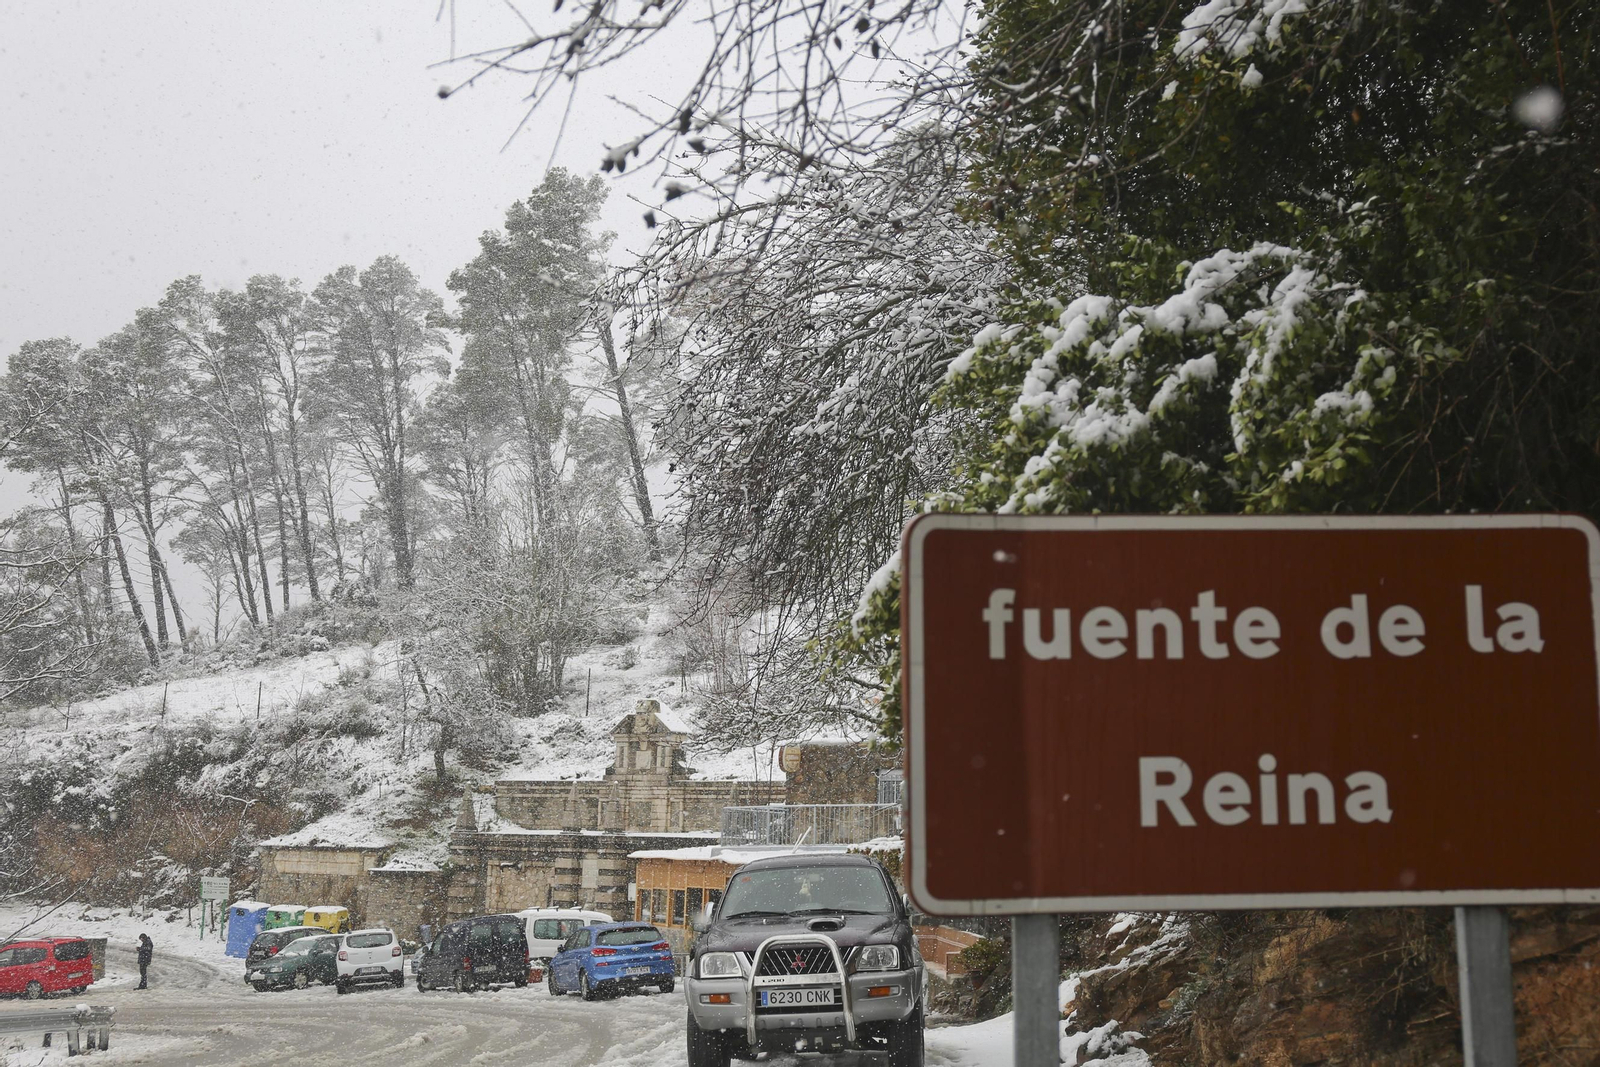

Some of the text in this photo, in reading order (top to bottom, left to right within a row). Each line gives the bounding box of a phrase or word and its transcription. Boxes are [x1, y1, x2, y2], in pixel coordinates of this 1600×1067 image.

[982, 584, 1544, 660] fuente de la
[1139, 754, 1393, 827] Reina
[770, 990, 831, 1004] 6230 CNK
